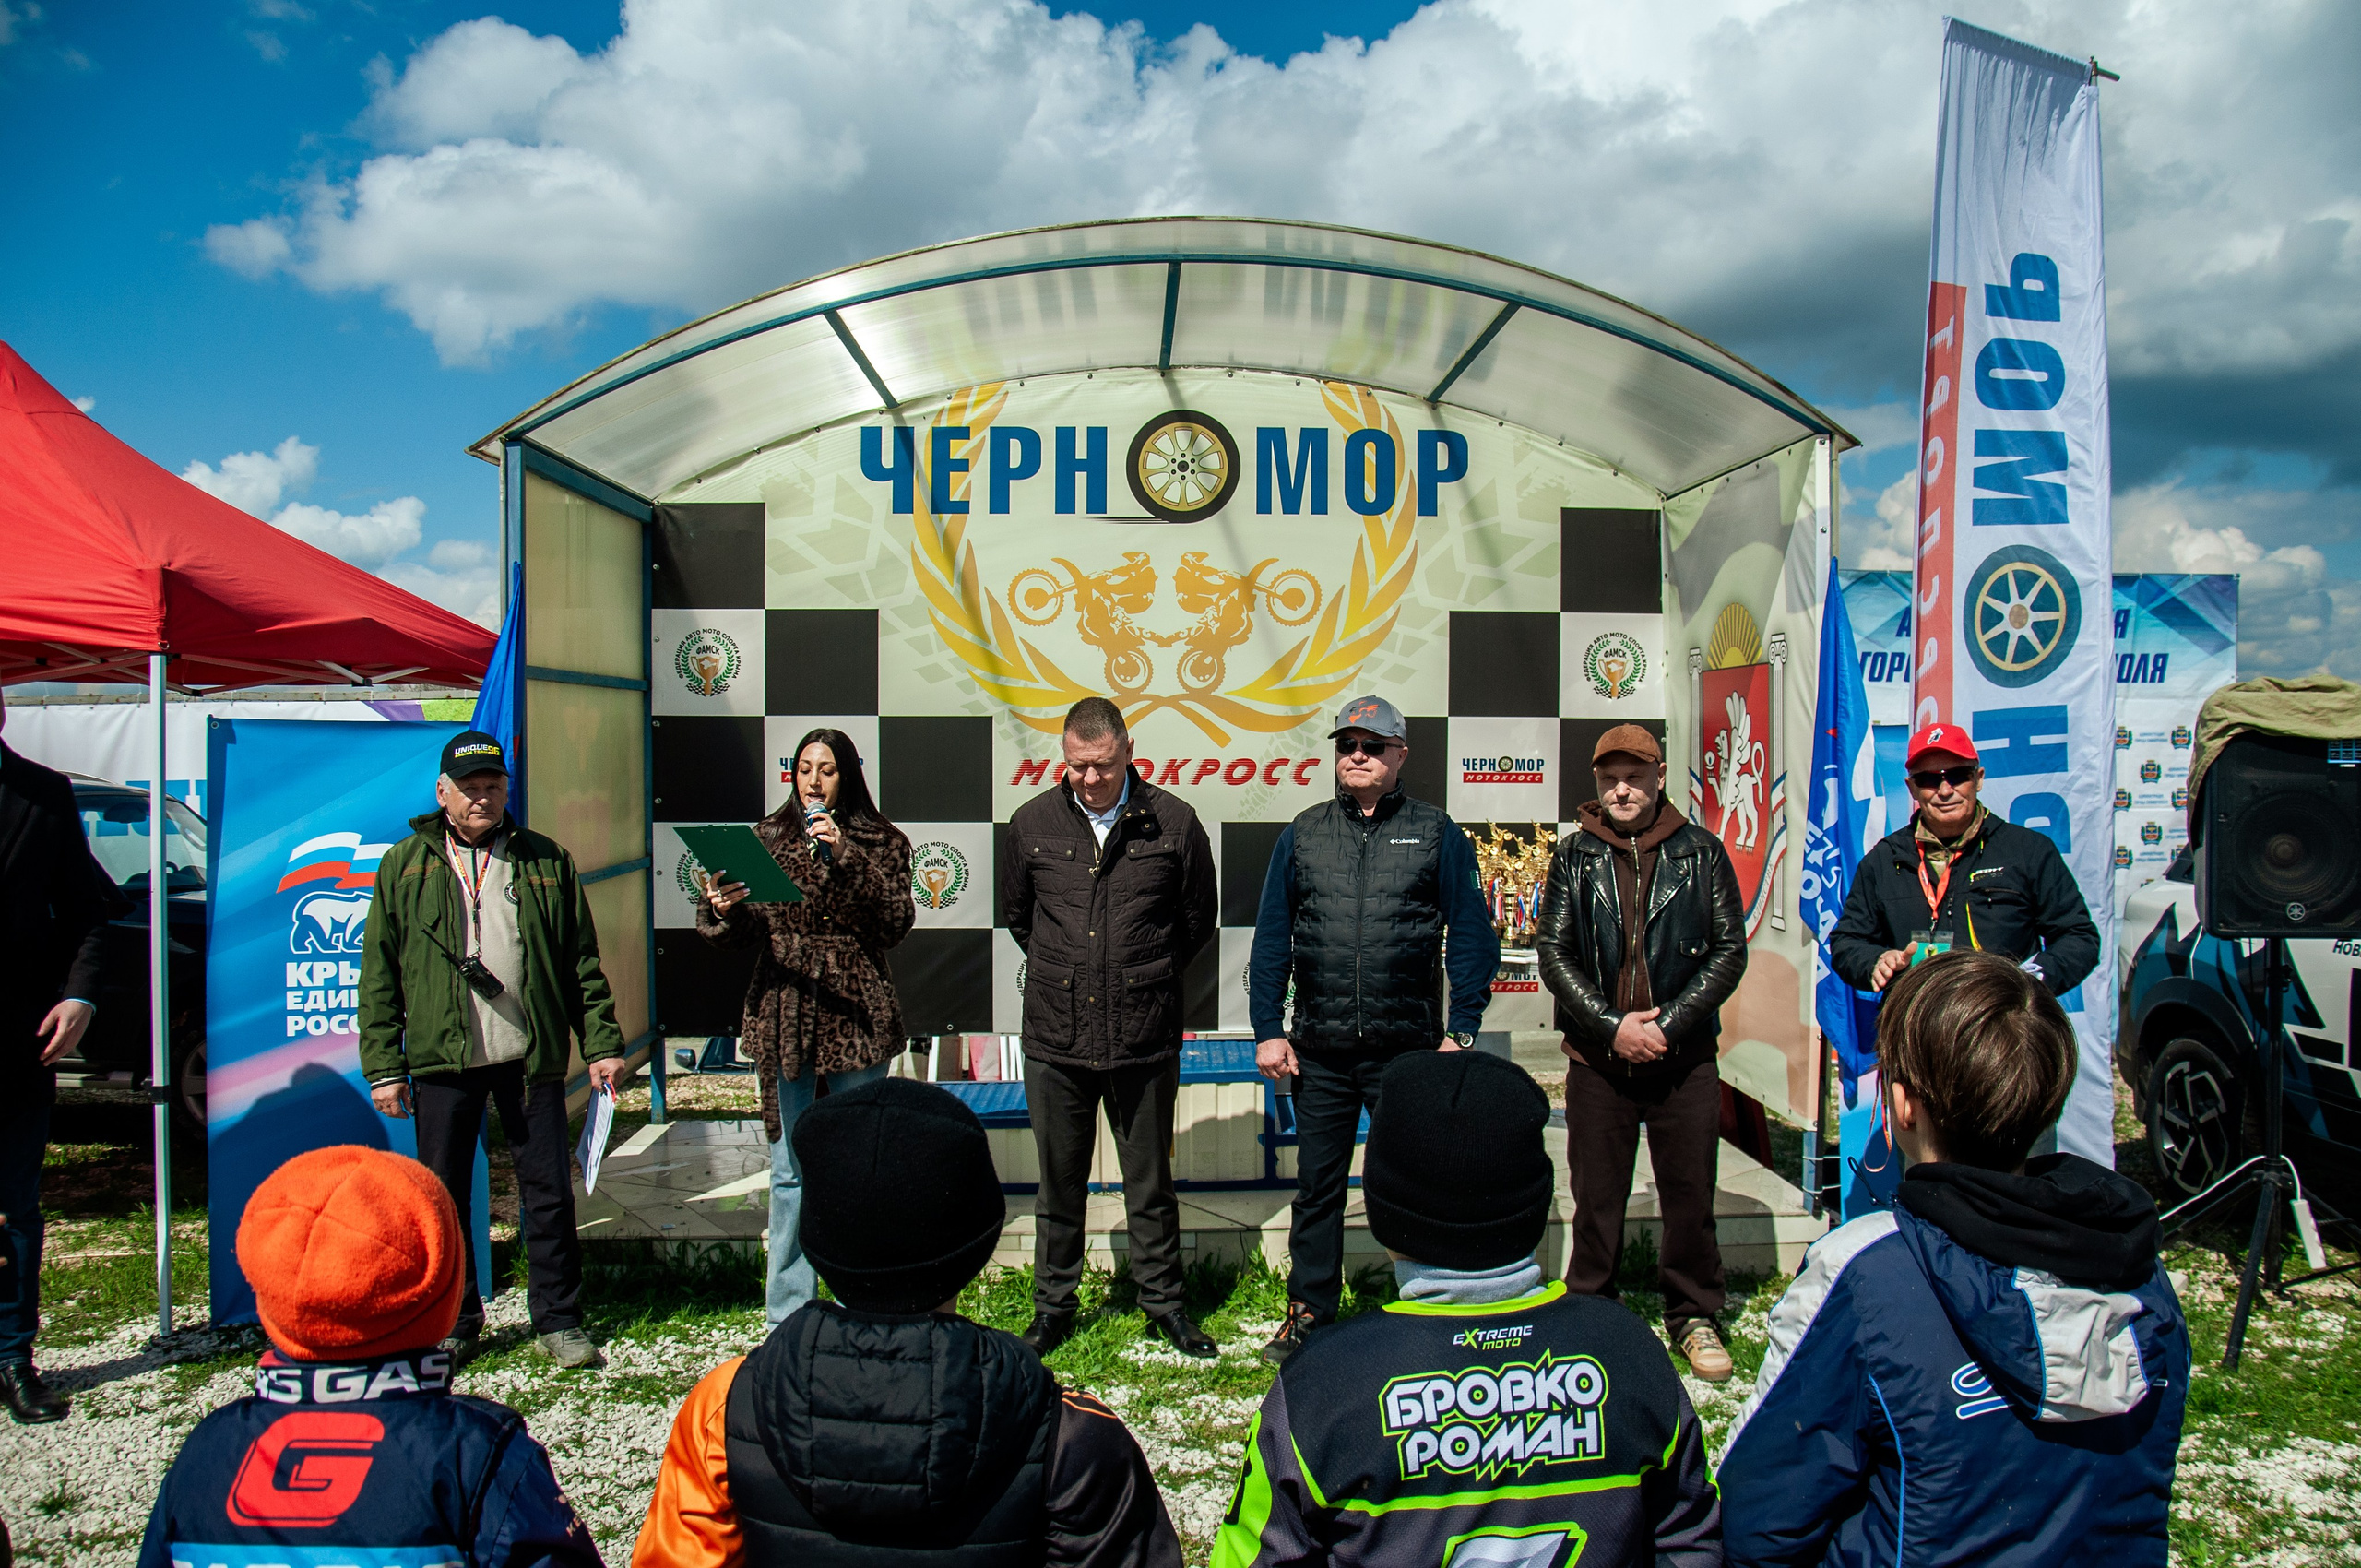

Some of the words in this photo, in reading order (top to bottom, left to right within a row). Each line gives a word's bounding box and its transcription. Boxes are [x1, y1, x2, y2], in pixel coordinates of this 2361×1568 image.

[675, 640, 686, 679] ФЕДЕРАЦИЯ
[685, 630, 701, 641] АВТО
[721, 633, 740, 654] СПОРТА
[731, 656, 742, 679] КРЫМА
[695, 645, 720, 655] ФАМСК
[1583, 644, 1594, 682] ФЕДЕРАЦИЯ
[1594, 634, 1608, 646] АВТО
[1628, 636, 1645, 658] СПОРТА
[1638, 659, 1647, 683] КРЫМА
[1603, 647, 1627, 659] ФАМСК
[1859, 651, 1911, 683] ГОР
[913, 843, 929, 854] АВТО
[950, 846, 967, 867] СПОРТА
[960, 868, 969, 892] КРЫМА
[924, 858, 948, 868] ФАМСК
[2332, 939, 2361, 957] НОВ
[286, 989, 359, 1012] ЕДИ
[314, 1353, 450, 1404] GAS
[1384, 1356, 1605, 1432] БРОВКО
[1404, 1409, 1600, 1476] РОМАН
